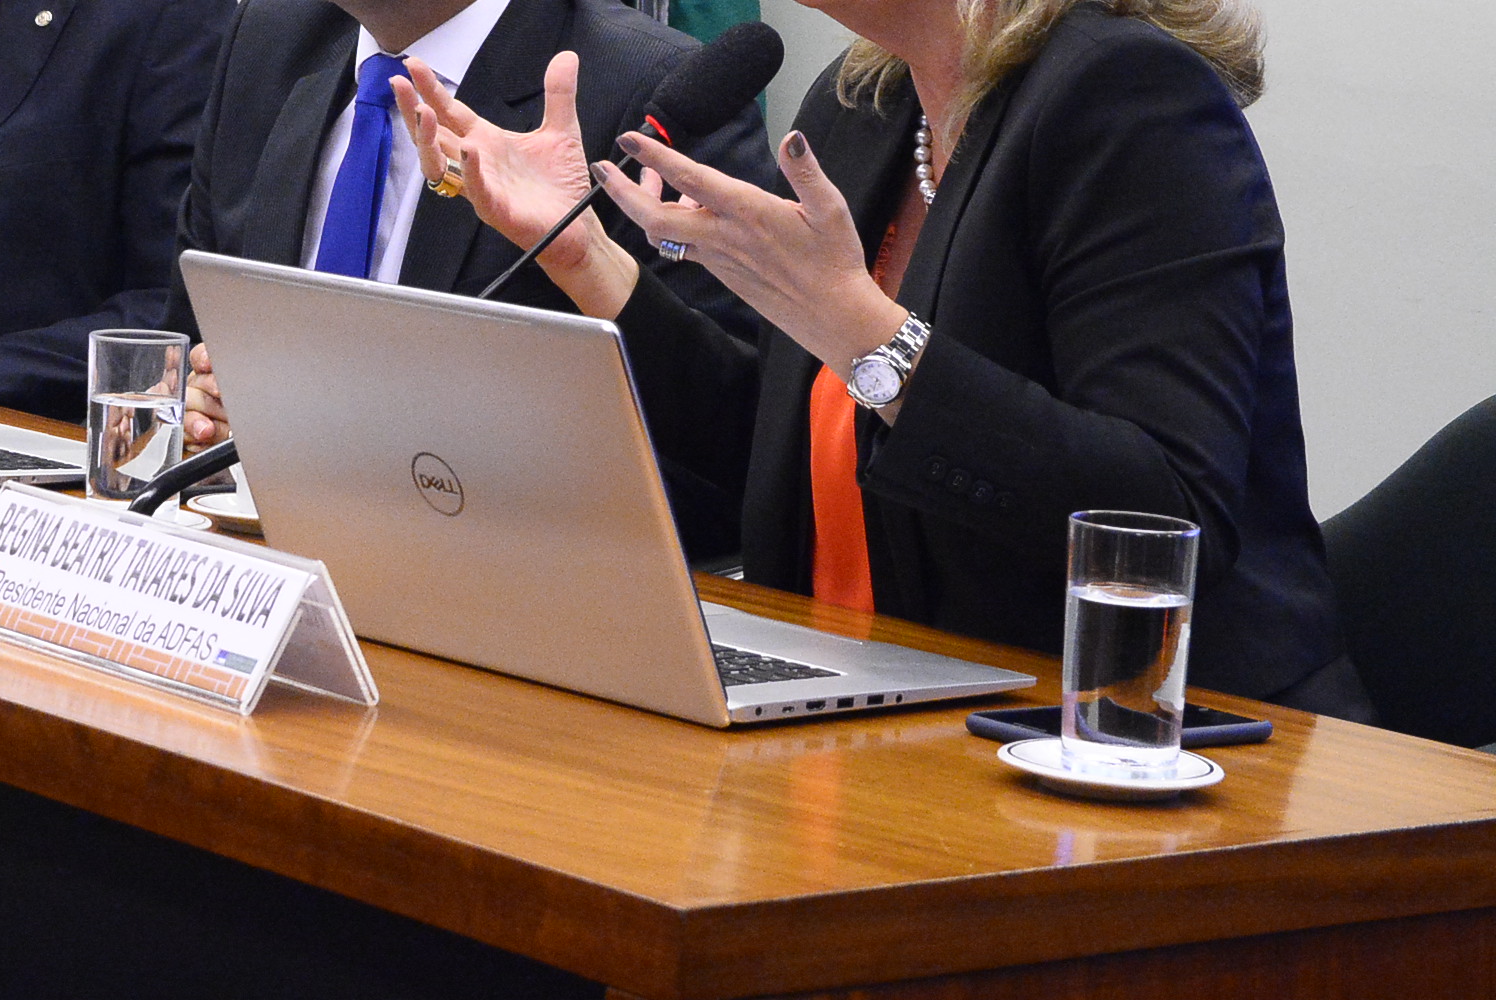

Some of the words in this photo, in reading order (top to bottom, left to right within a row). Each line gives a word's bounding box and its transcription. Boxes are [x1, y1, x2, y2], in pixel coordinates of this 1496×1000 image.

[418, 473, 461, 495] DELL
[50, 520, 133, 584] BEATRIZ
[118, 537, 209, 606] TAVARES
[192, 561, 230, 614] DA
[220, 568, 287, 629] SILVA
[64, 593, 132, 637] Nacional
[132, 616, 154, 640] da
[152, 619, 219, 661] ADFAS
